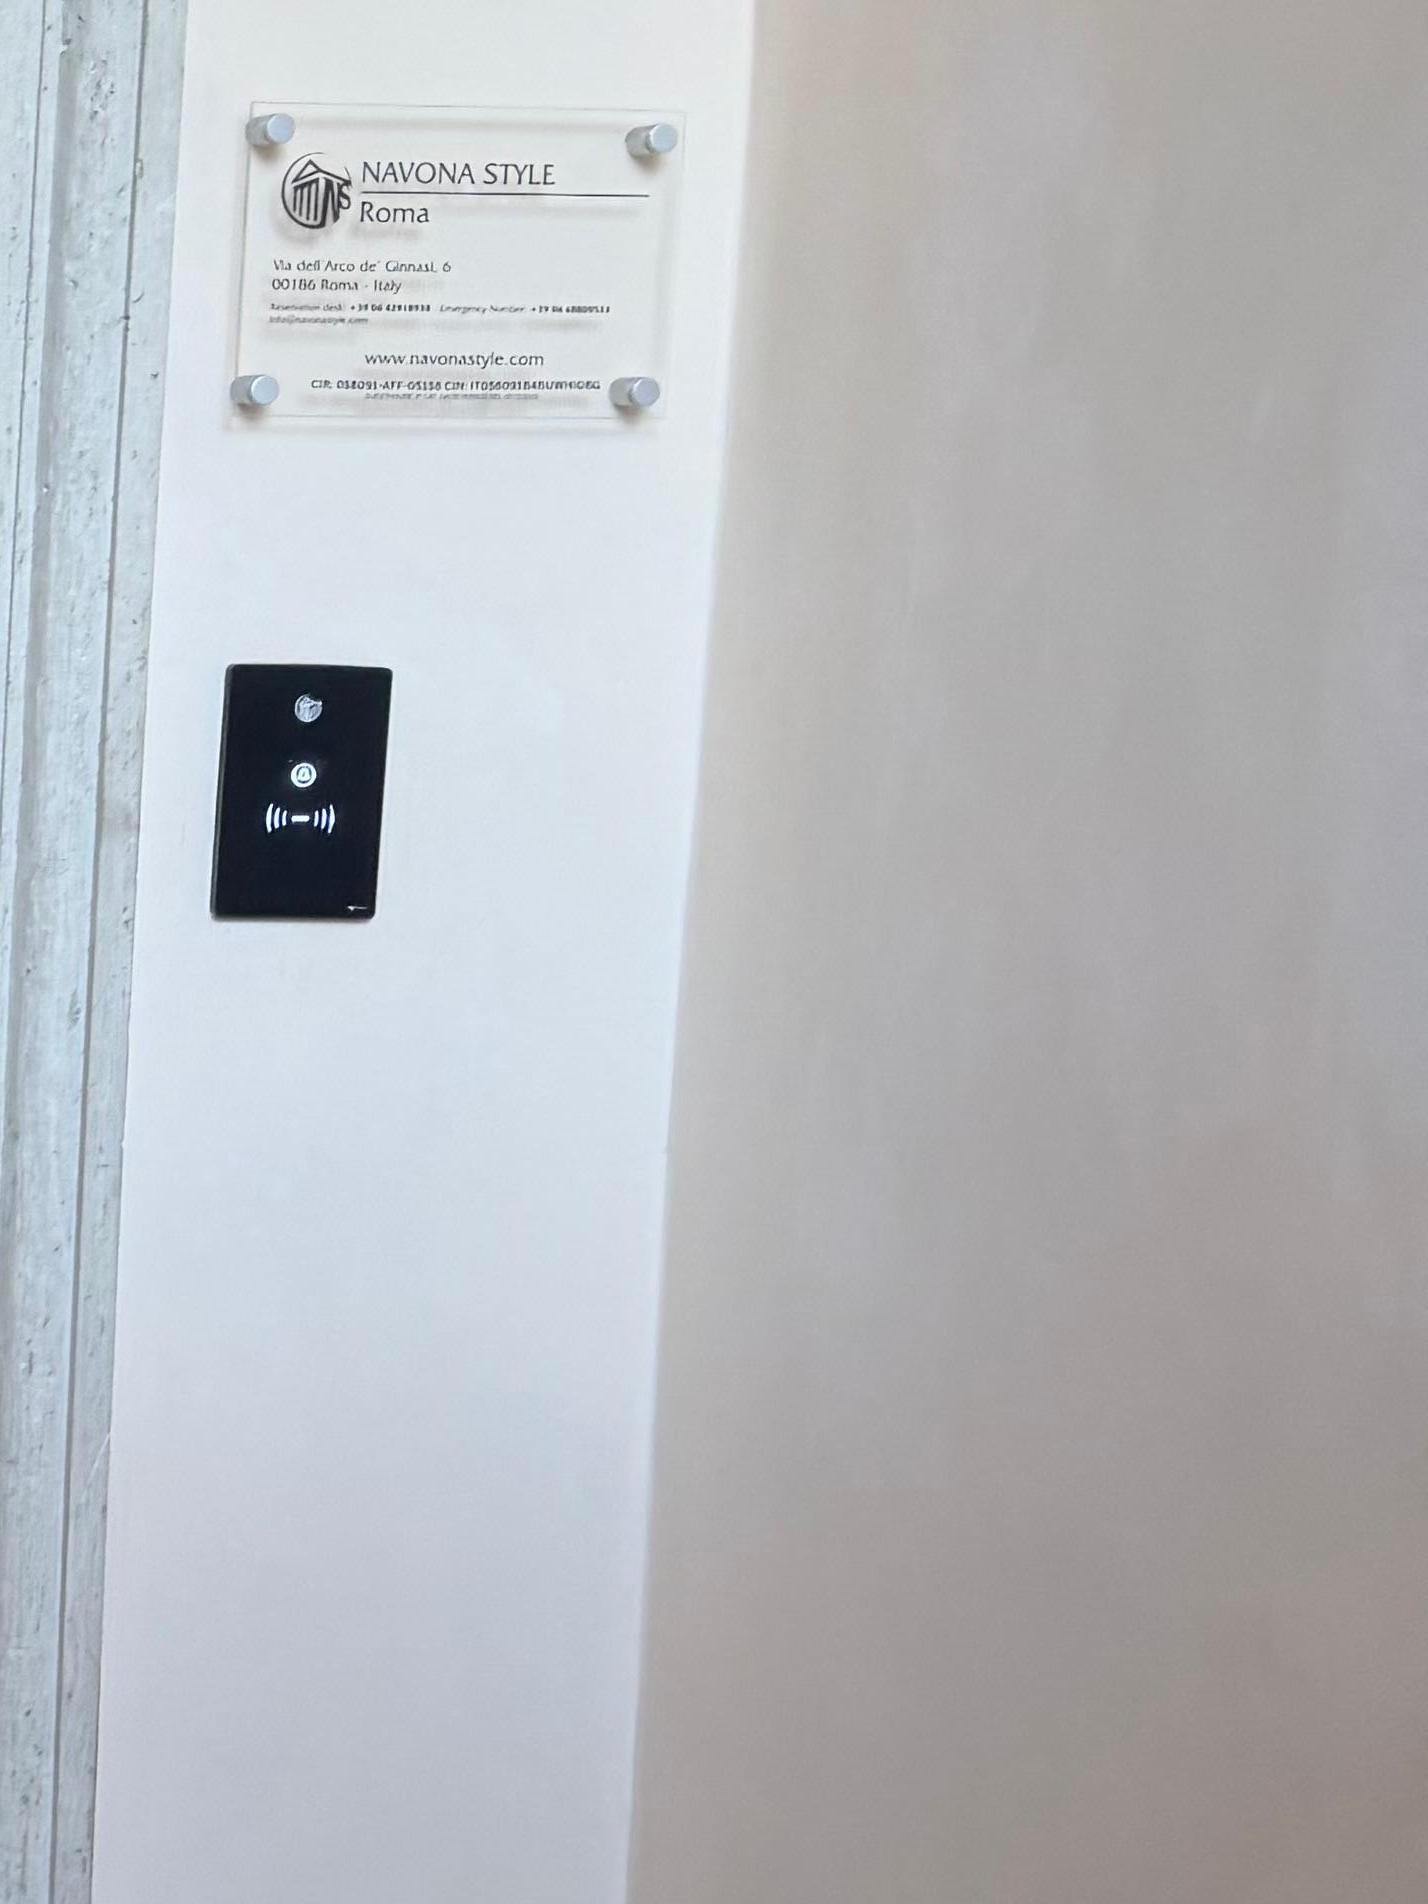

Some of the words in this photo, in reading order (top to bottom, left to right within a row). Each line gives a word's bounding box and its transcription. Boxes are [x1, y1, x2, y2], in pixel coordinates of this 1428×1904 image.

[362, 161, 475, 185] NAVONA
[483, 162, 556, 186] STYLE
[359, 201, 430, 224] Roma
[273, 259, 292, 272] Via
[442, 261, 452, 273] 6
[271, 278, 316, 291] 00186
[320, 278, 359, 291] Roma
[373, 279, 402, 294] Italy
[364, 351, 544, 369] www.navonastyle.com
